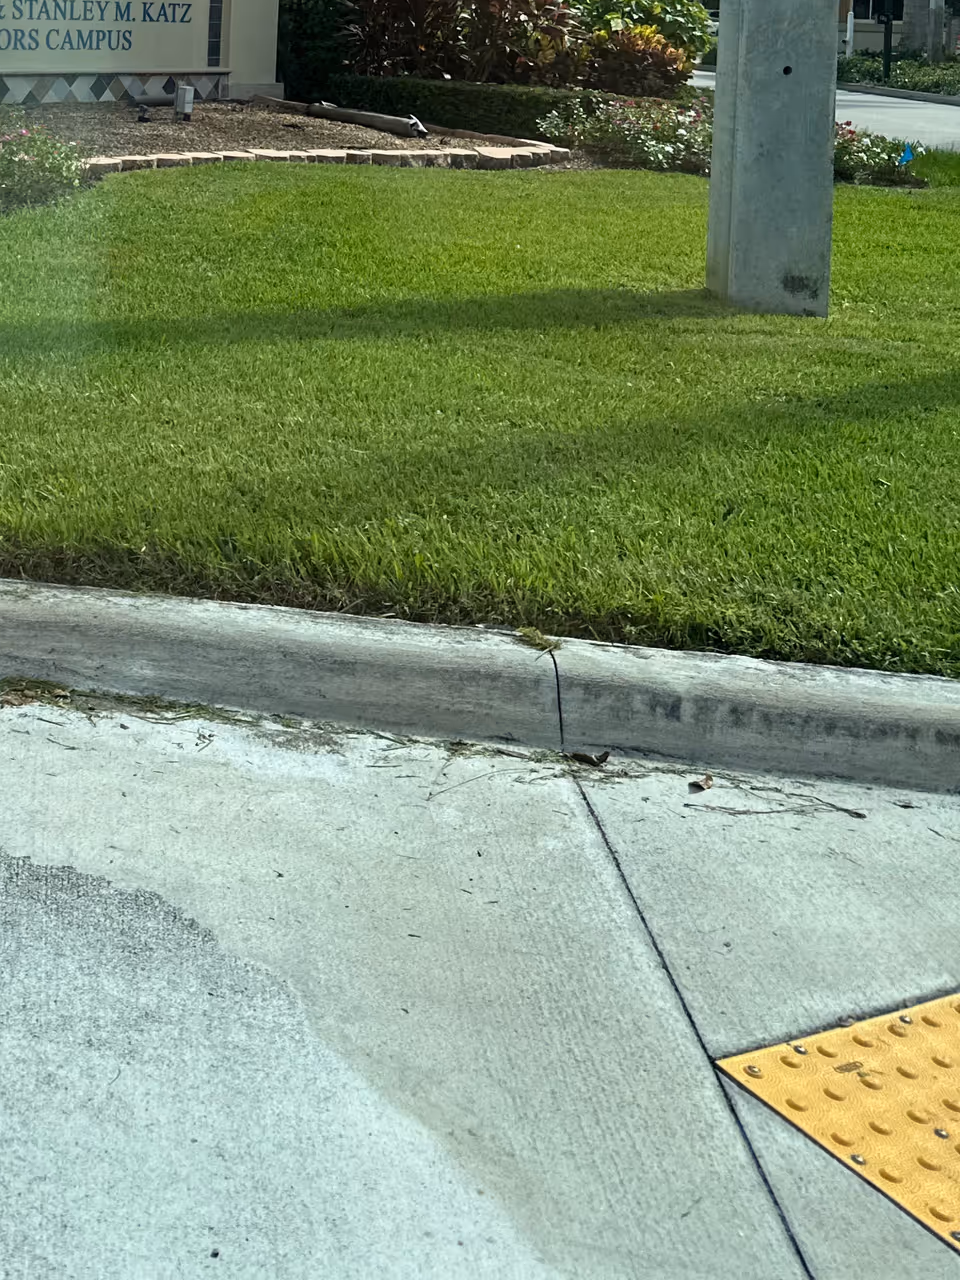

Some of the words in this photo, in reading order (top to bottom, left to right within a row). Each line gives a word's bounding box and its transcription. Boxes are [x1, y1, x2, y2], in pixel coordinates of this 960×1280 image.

[113, 1, 136, 23] M.
[141, 2, 193, 24] KATZ
[45, 29, 133, 52] CAMPUS
